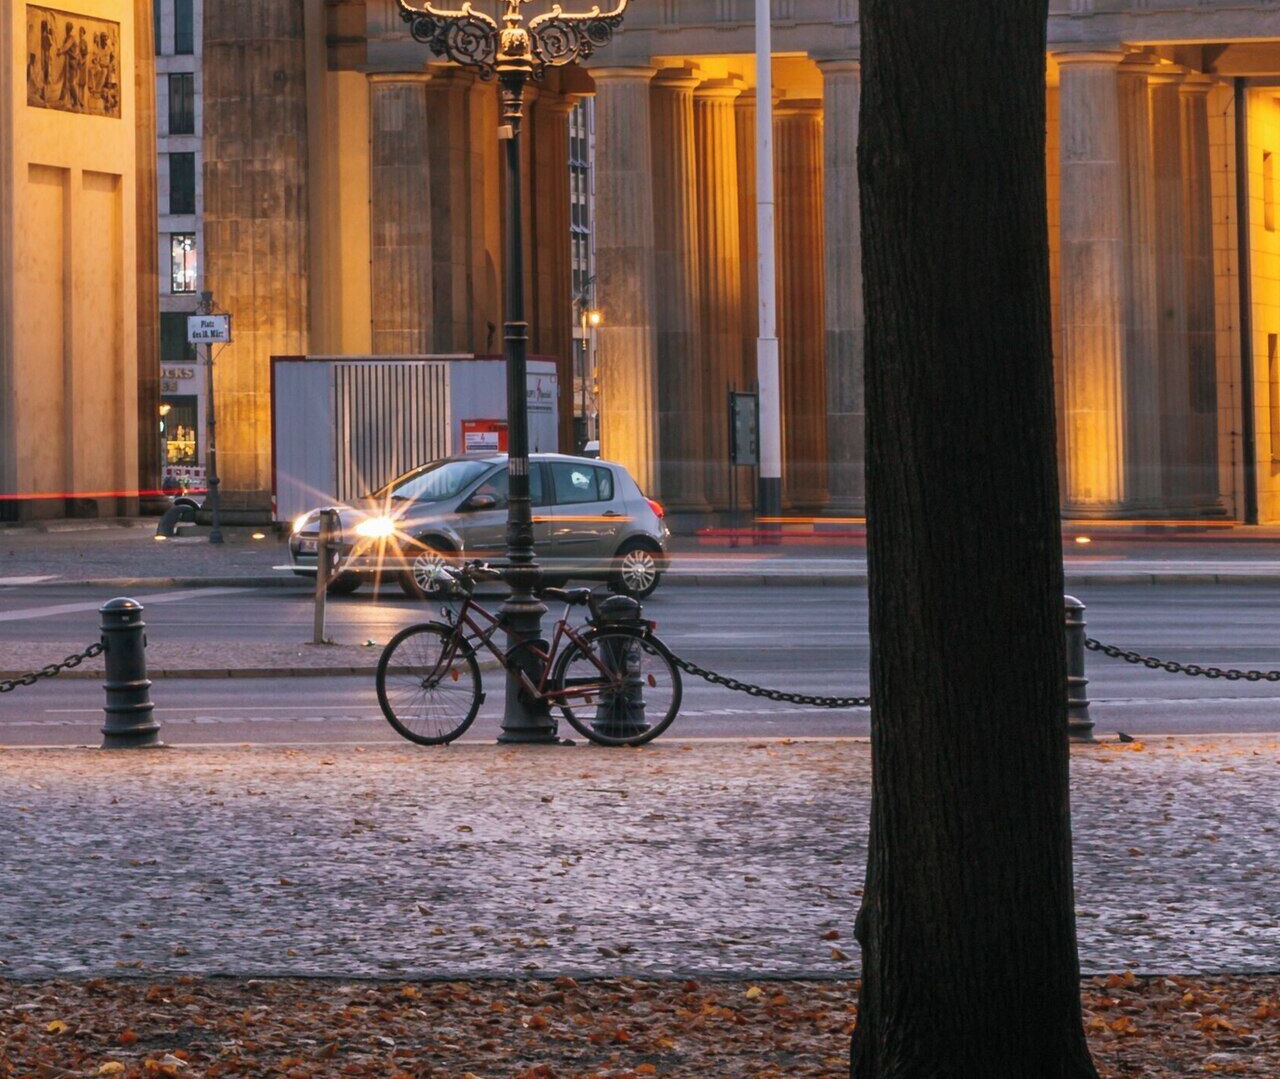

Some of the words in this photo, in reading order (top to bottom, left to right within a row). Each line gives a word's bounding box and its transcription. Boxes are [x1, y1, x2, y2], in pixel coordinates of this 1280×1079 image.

[200, 320, 215, 328] Platz
[192, 330, 201, 338] des
[210, 329, 224, 338] März
